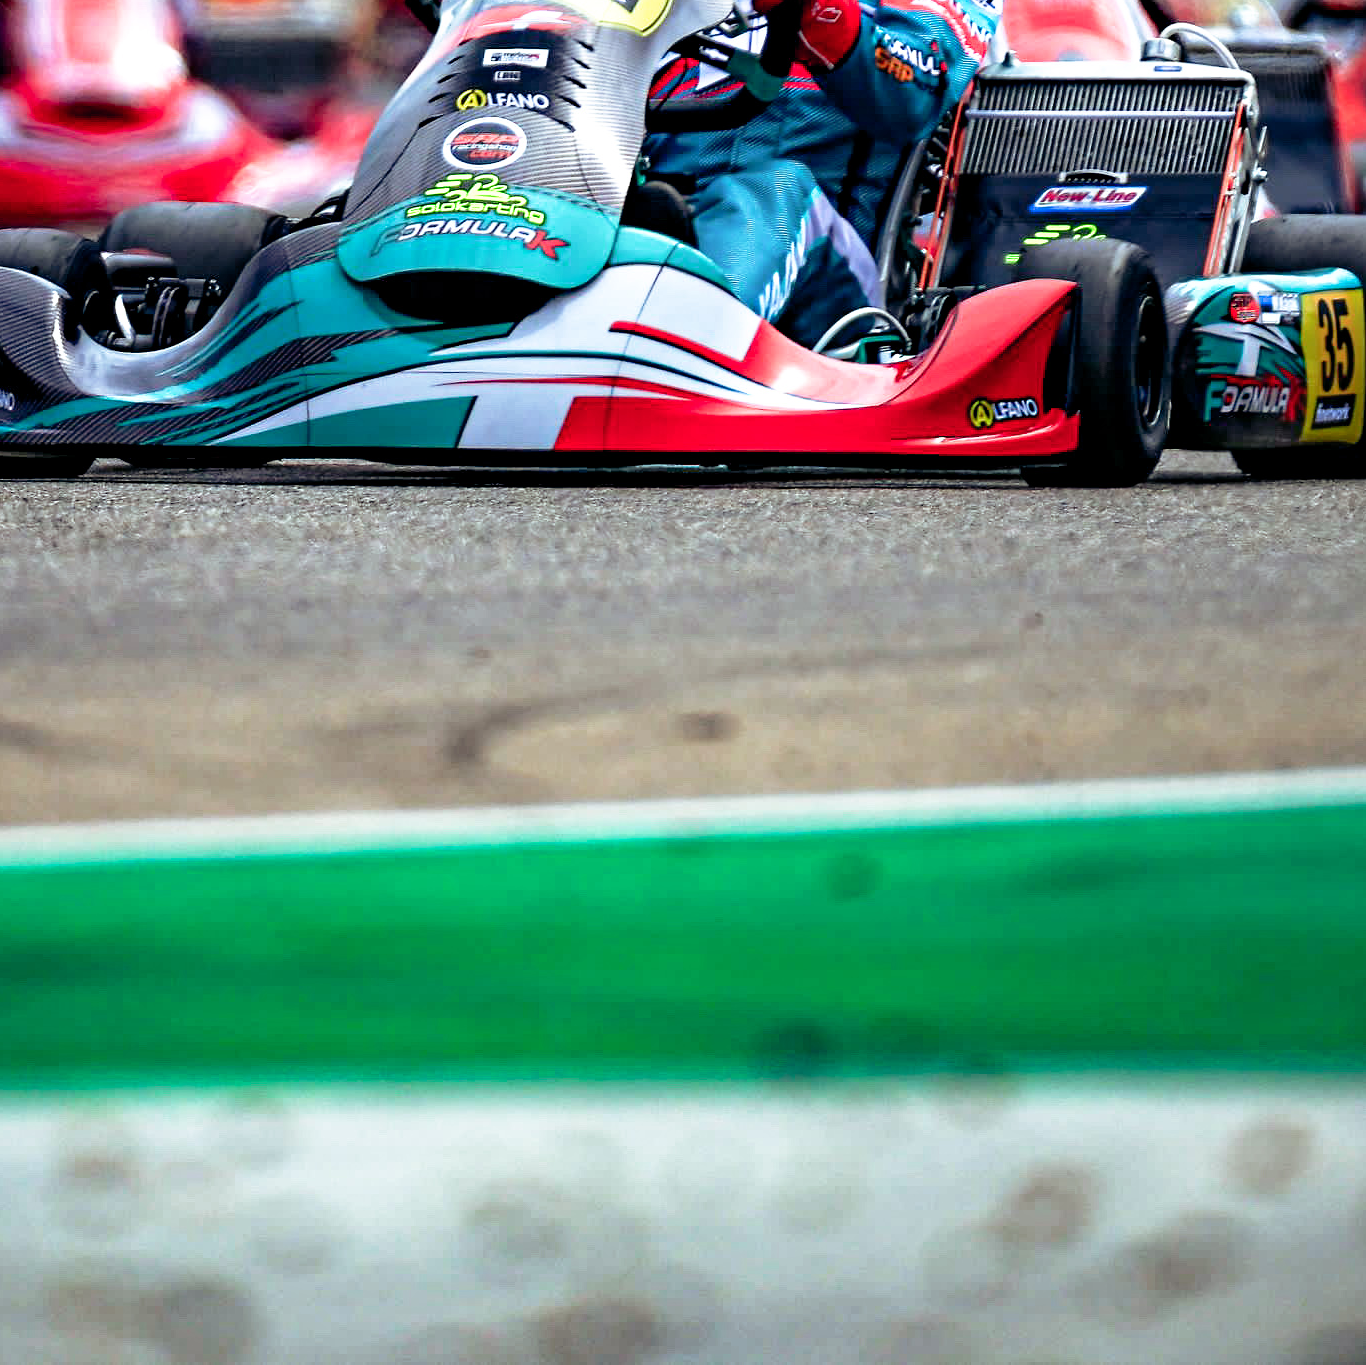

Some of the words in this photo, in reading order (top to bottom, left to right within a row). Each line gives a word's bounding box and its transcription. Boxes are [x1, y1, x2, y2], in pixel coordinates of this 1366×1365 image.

[456, 89, 550, 111] ALFANO
[404, 200, 546, 226] solokarting
[1317, 297, 1356, 393] 35
[970, 399, 1038, 427] ALFANO
